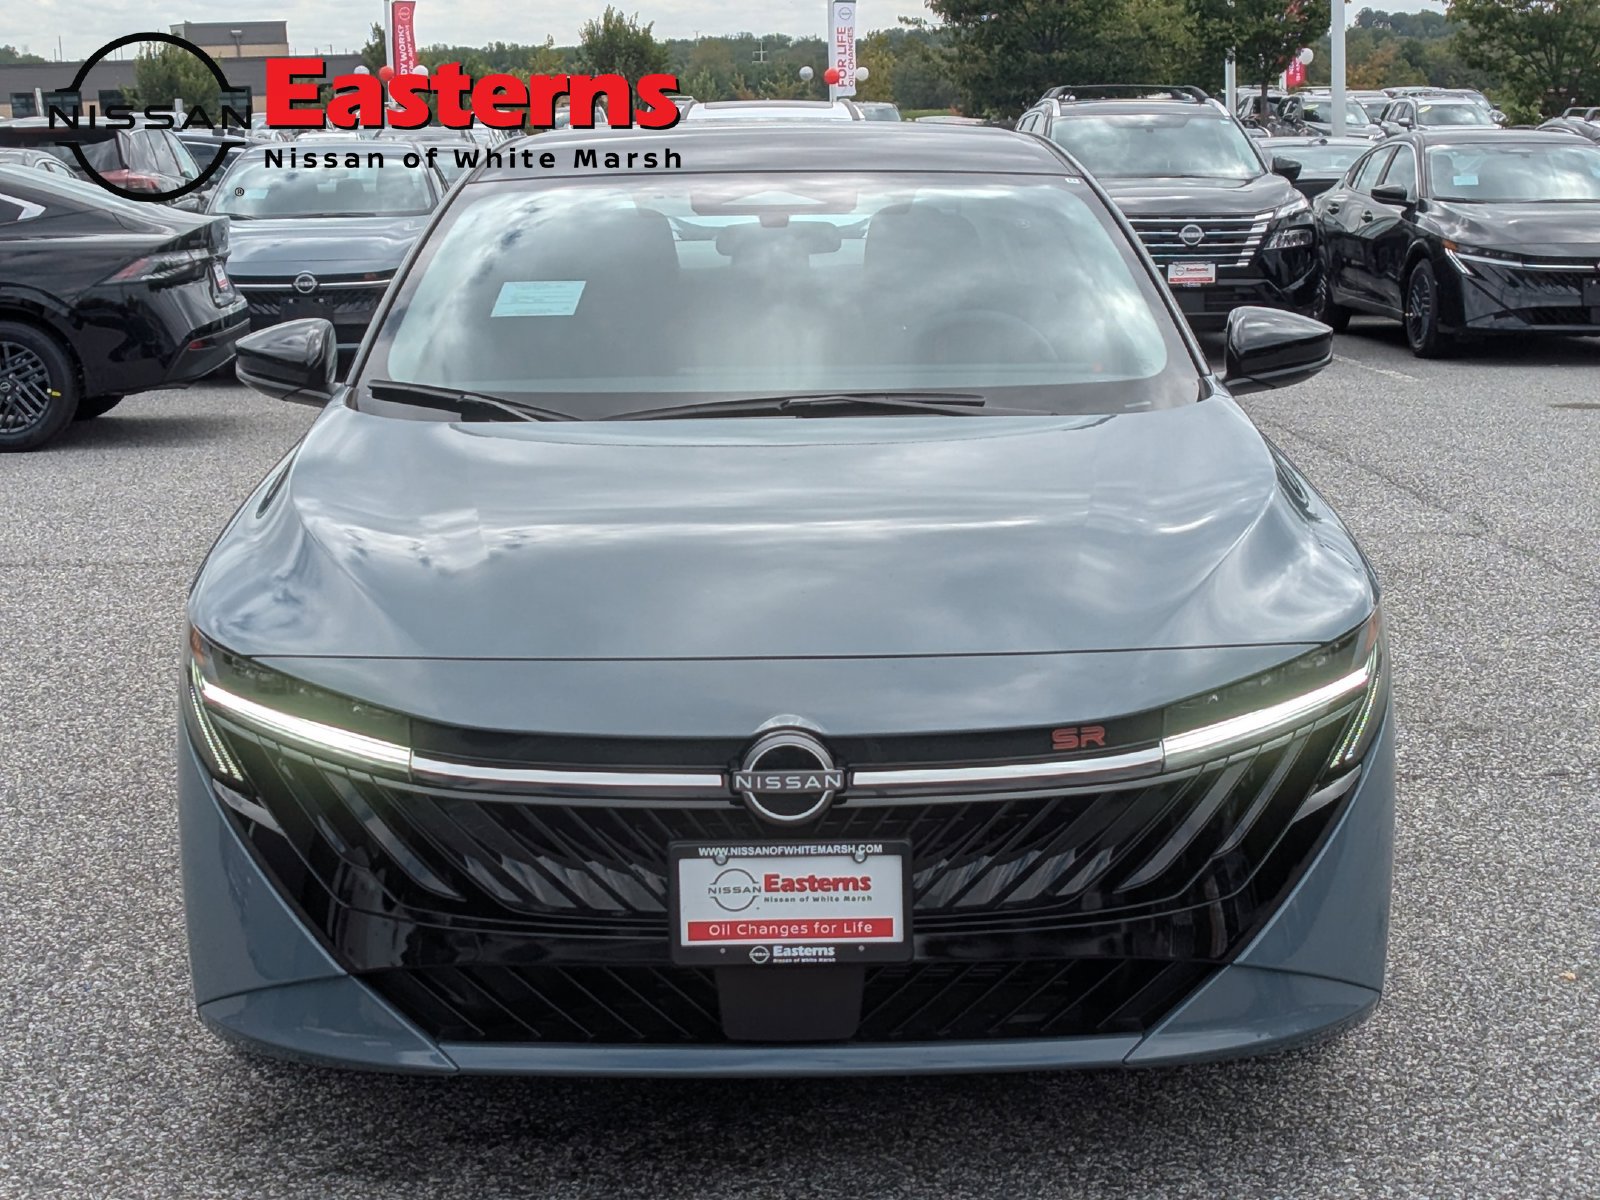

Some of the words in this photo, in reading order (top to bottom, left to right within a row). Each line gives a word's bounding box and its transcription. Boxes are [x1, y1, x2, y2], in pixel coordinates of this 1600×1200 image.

[397, 24, 408, 62] WORK?
[836, 26, 847, 55] LIFE
[847, 26, 855, 71] CHANGES
[837, 59, 848, 88] FOR
[1051, 725, 1106, 751] SR
[735, 772, 842, 790] NISSAN
[698, 844, 883, 857] WWW.NISSANOFWHITEMARSH.COM
[707, 885, 762, 895] NISSAN
[763, 873, 872, 893] Easterns
[799, 895, 809, 903] of
[812, 895, 840, 903] White
[843, 894, 873, 902] Marsh
[708, 923, 731, 936] Oil
[736, 922, 808, 937] Changes
[813, 921, 837, 934] for
[843, 921, 873, 934] Life
[773, 945, 836, 957] Easterns
